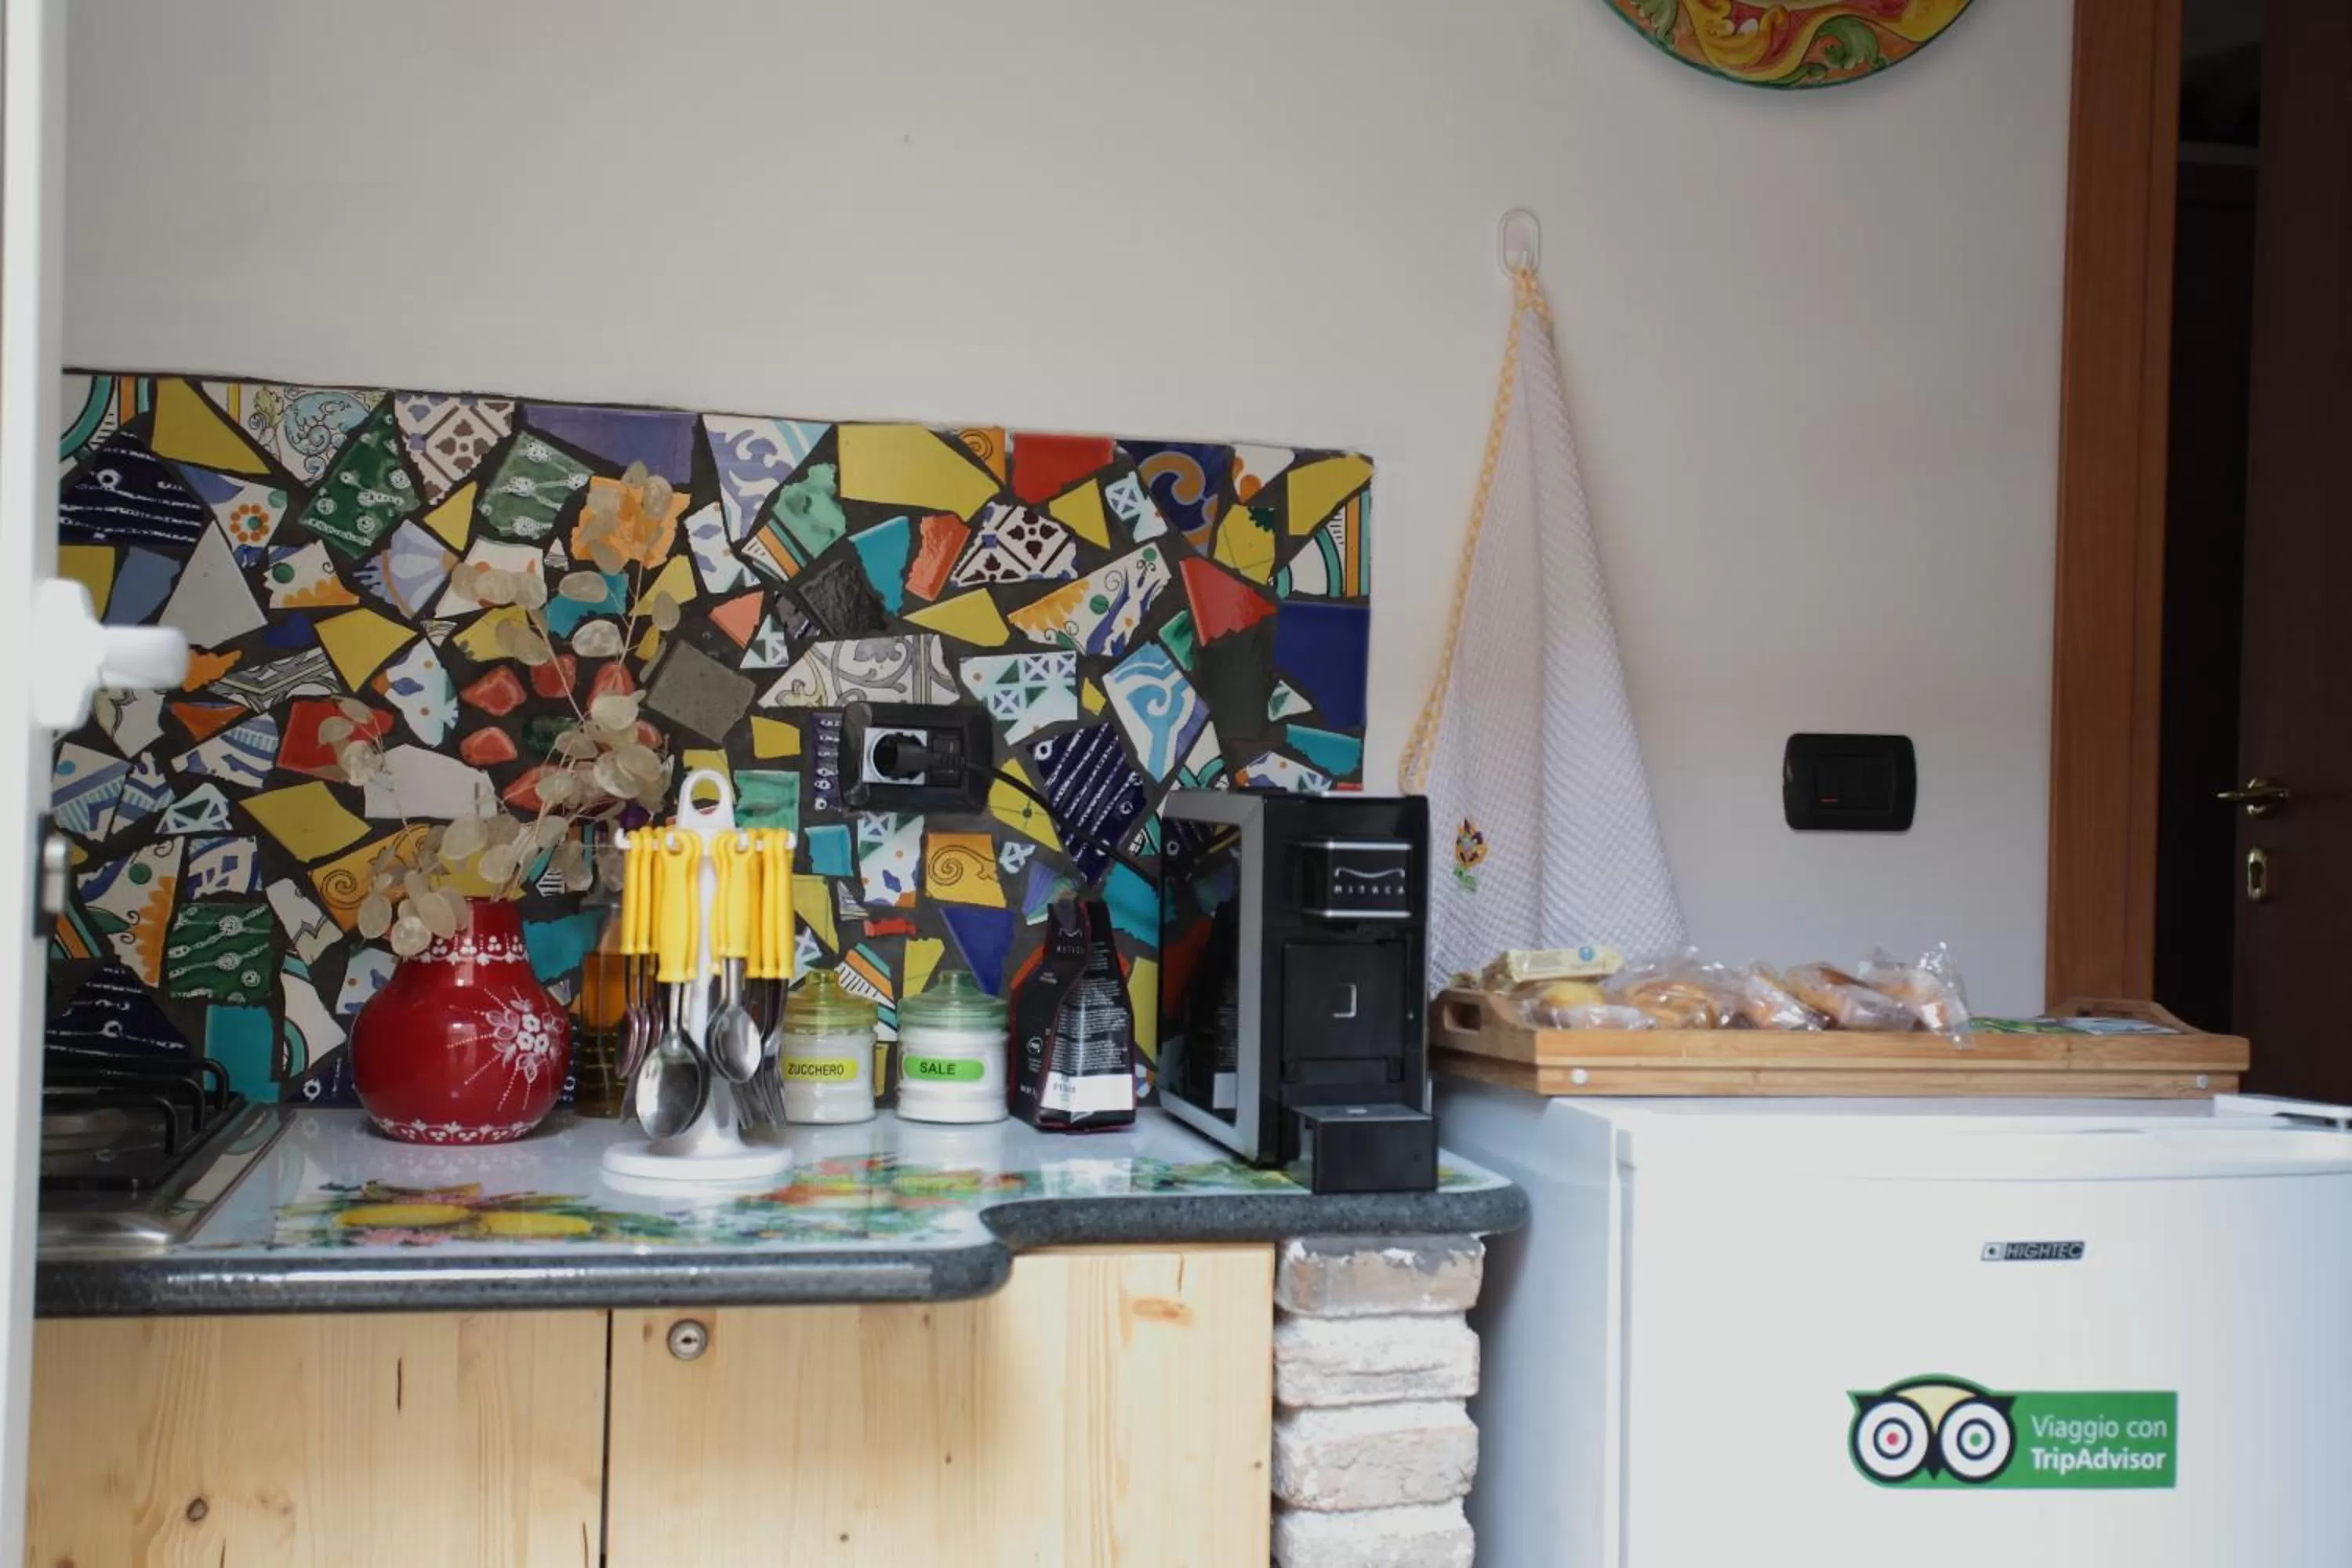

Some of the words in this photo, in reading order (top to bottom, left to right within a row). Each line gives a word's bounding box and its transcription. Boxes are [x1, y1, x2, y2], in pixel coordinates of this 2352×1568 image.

[788, 1062, 844, 1076] ZUCCHERO
[919, 1062, 956, 1075] SALE
[2005, 1242, 2084, 1259] HIGHTEC
[2031, 1414, 2120, 1444] Viaggio
[2125, 1420, 2168, 1439] con
[2031, 1446, 2166, 1475] TripAdvisor
